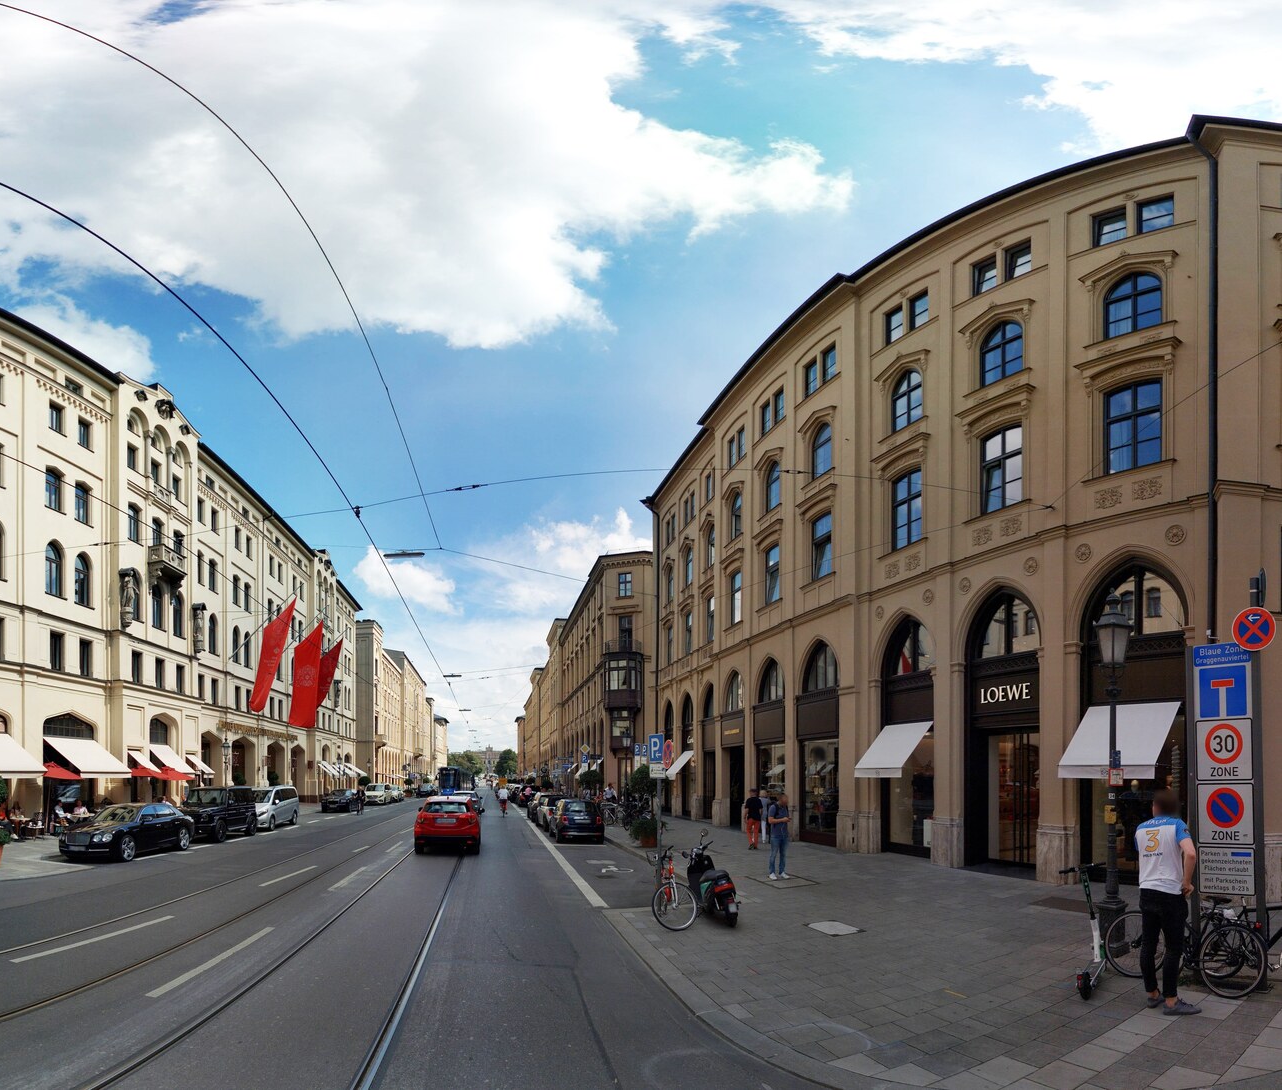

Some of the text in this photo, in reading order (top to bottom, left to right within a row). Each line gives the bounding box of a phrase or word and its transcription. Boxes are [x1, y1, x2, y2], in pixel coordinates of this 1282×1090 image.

[1199, 648, 1222, 656] Blaue
[1195, 654, 1249, 665] Graggenauviertel
[980, 682, 1031, 704] LOEWE
[651, 738, 660, 759] P
[1212, 734, 1235, 754] 30
[1210, 766, 1239, 777] ZONE
[1145, 829, 1160, 852] 3
[1211, 830, 1240, 841] ZONE
[1204, 864, 1227, 872] Flächen
[1216, 877, 1248, 885] Parkschein
